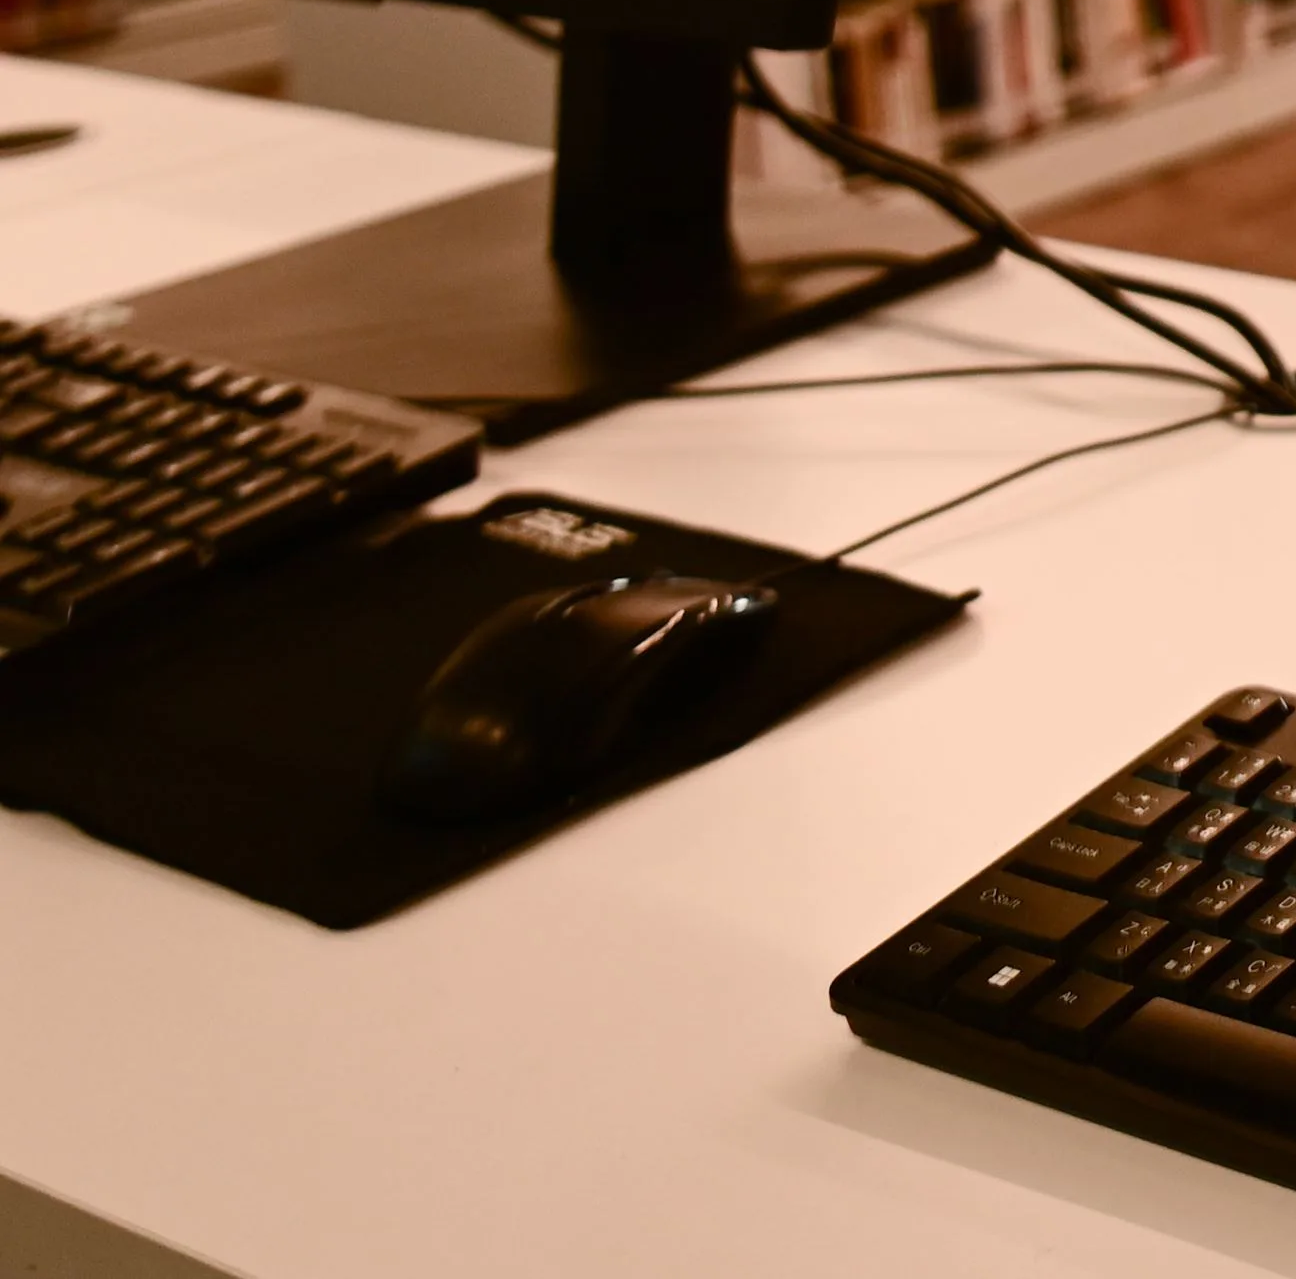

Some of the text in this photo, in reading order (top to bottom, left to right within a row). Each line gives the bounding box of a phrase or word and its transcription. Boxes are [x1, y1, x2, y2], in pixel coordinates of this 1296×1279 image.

[1155, 860, 1173, 874] A
[1216, 877, 1234, 893] S
[1119, 921, 1141, 936] Z
[1182, 939, 1201, 957] X
[1247, 959, 1266, 974] C
